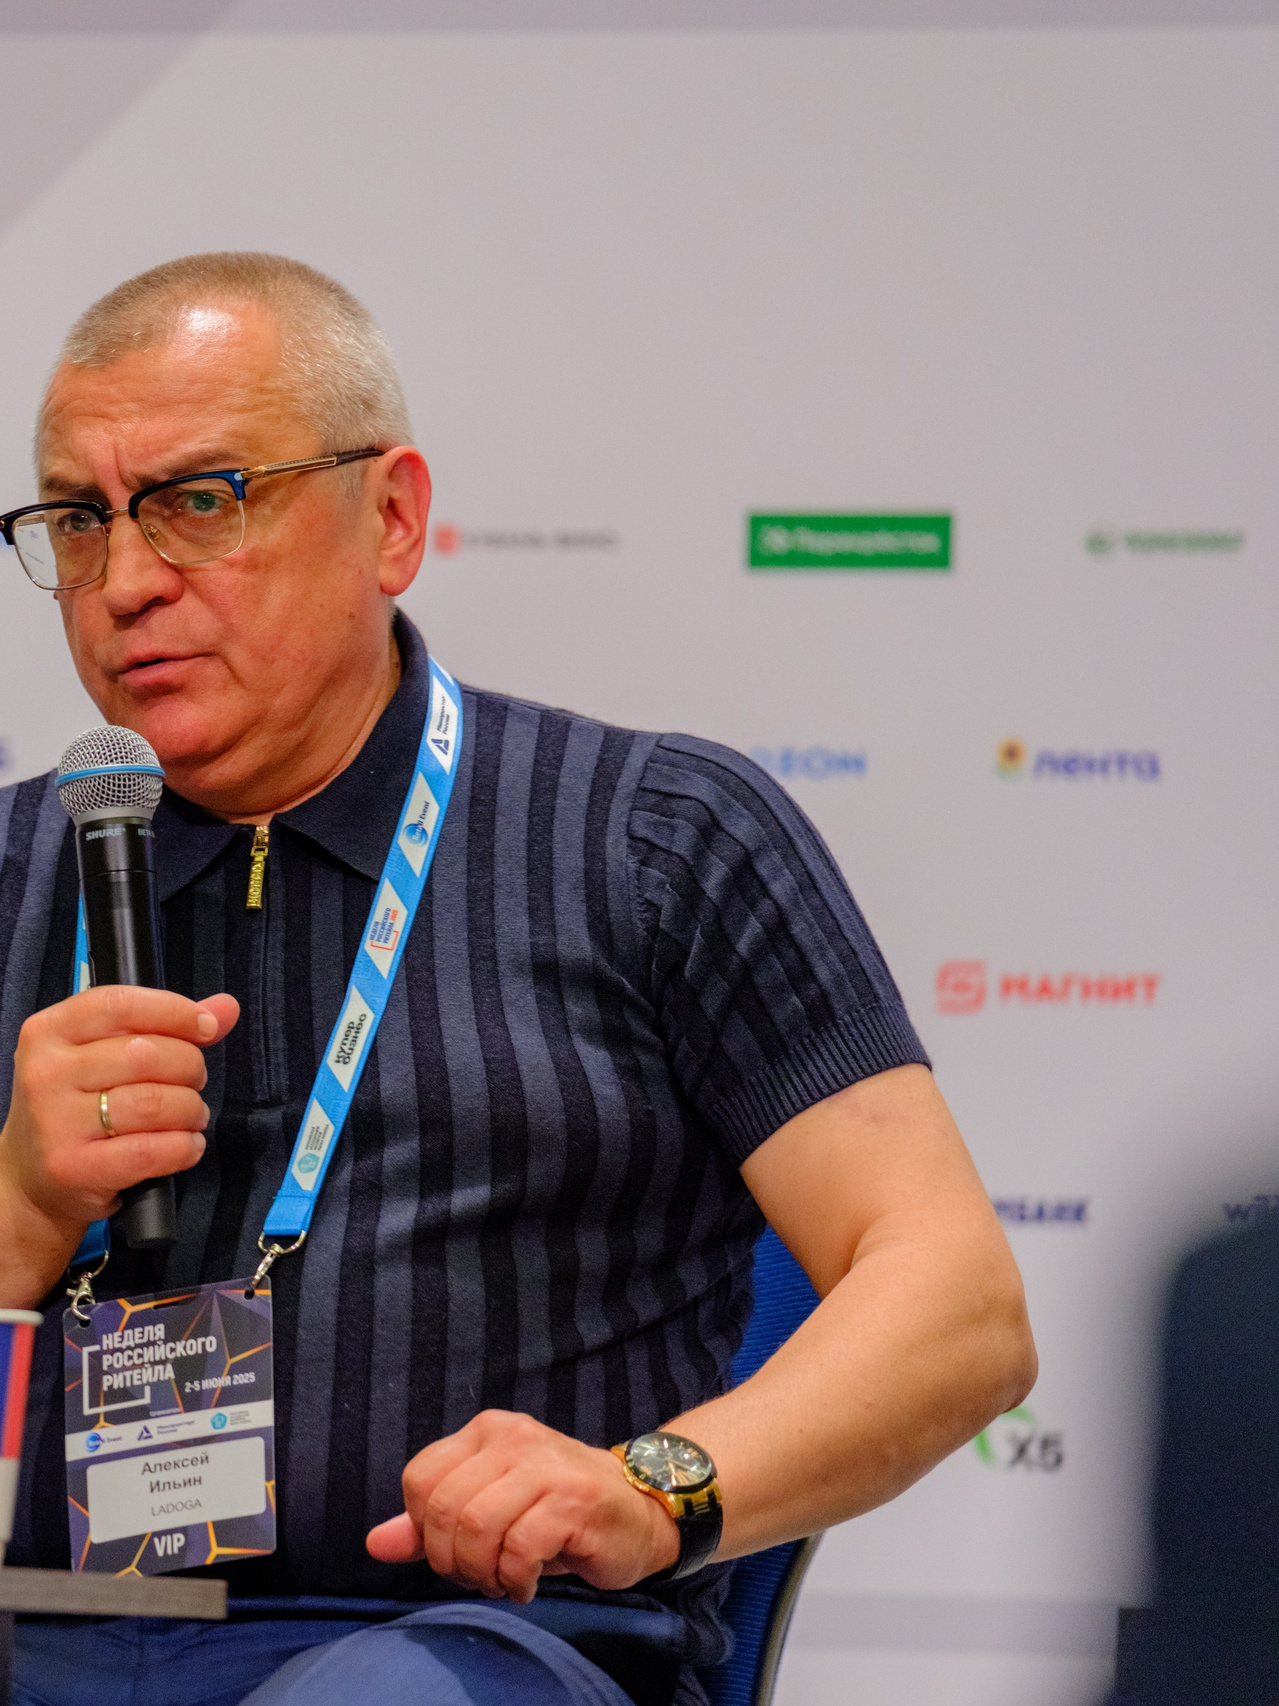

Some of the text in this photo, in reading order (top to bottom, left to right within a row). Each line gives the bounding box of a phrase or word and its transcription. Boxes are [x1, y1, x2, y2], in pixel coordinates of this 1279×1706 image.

[418, 800, 430, 820] Event
[86, 828, 122, 841] SHURE
[368, 920, 380, 940] НЕДЕЛЯ
[375, 907, 391, 942] РОССИЙСКОГО
[382, 921, 394, 943] РИТЕЙЛА
[1000, 973, 1159, 1003] МАГНИТ
[333, 1019, 354, 1063] купер
[102, 1323, 165, 1350] НЕДЕЛЯ
[102, 1335, 217, 1370] РОССИЙСКОГО
[102, 1362, 175, 1391] РИТЕЙЛА
[201, 1376, 231, 1390] ИЮНЯ
[232, 1371, 256, 1386] 2025
[141, 1452, 209, 1475] Алексей
[149, 1475, 203, 1494] Ильин
[151, 1498, 202, 1516] LADOGA
[153, 1533, 186, 1557] VIP
